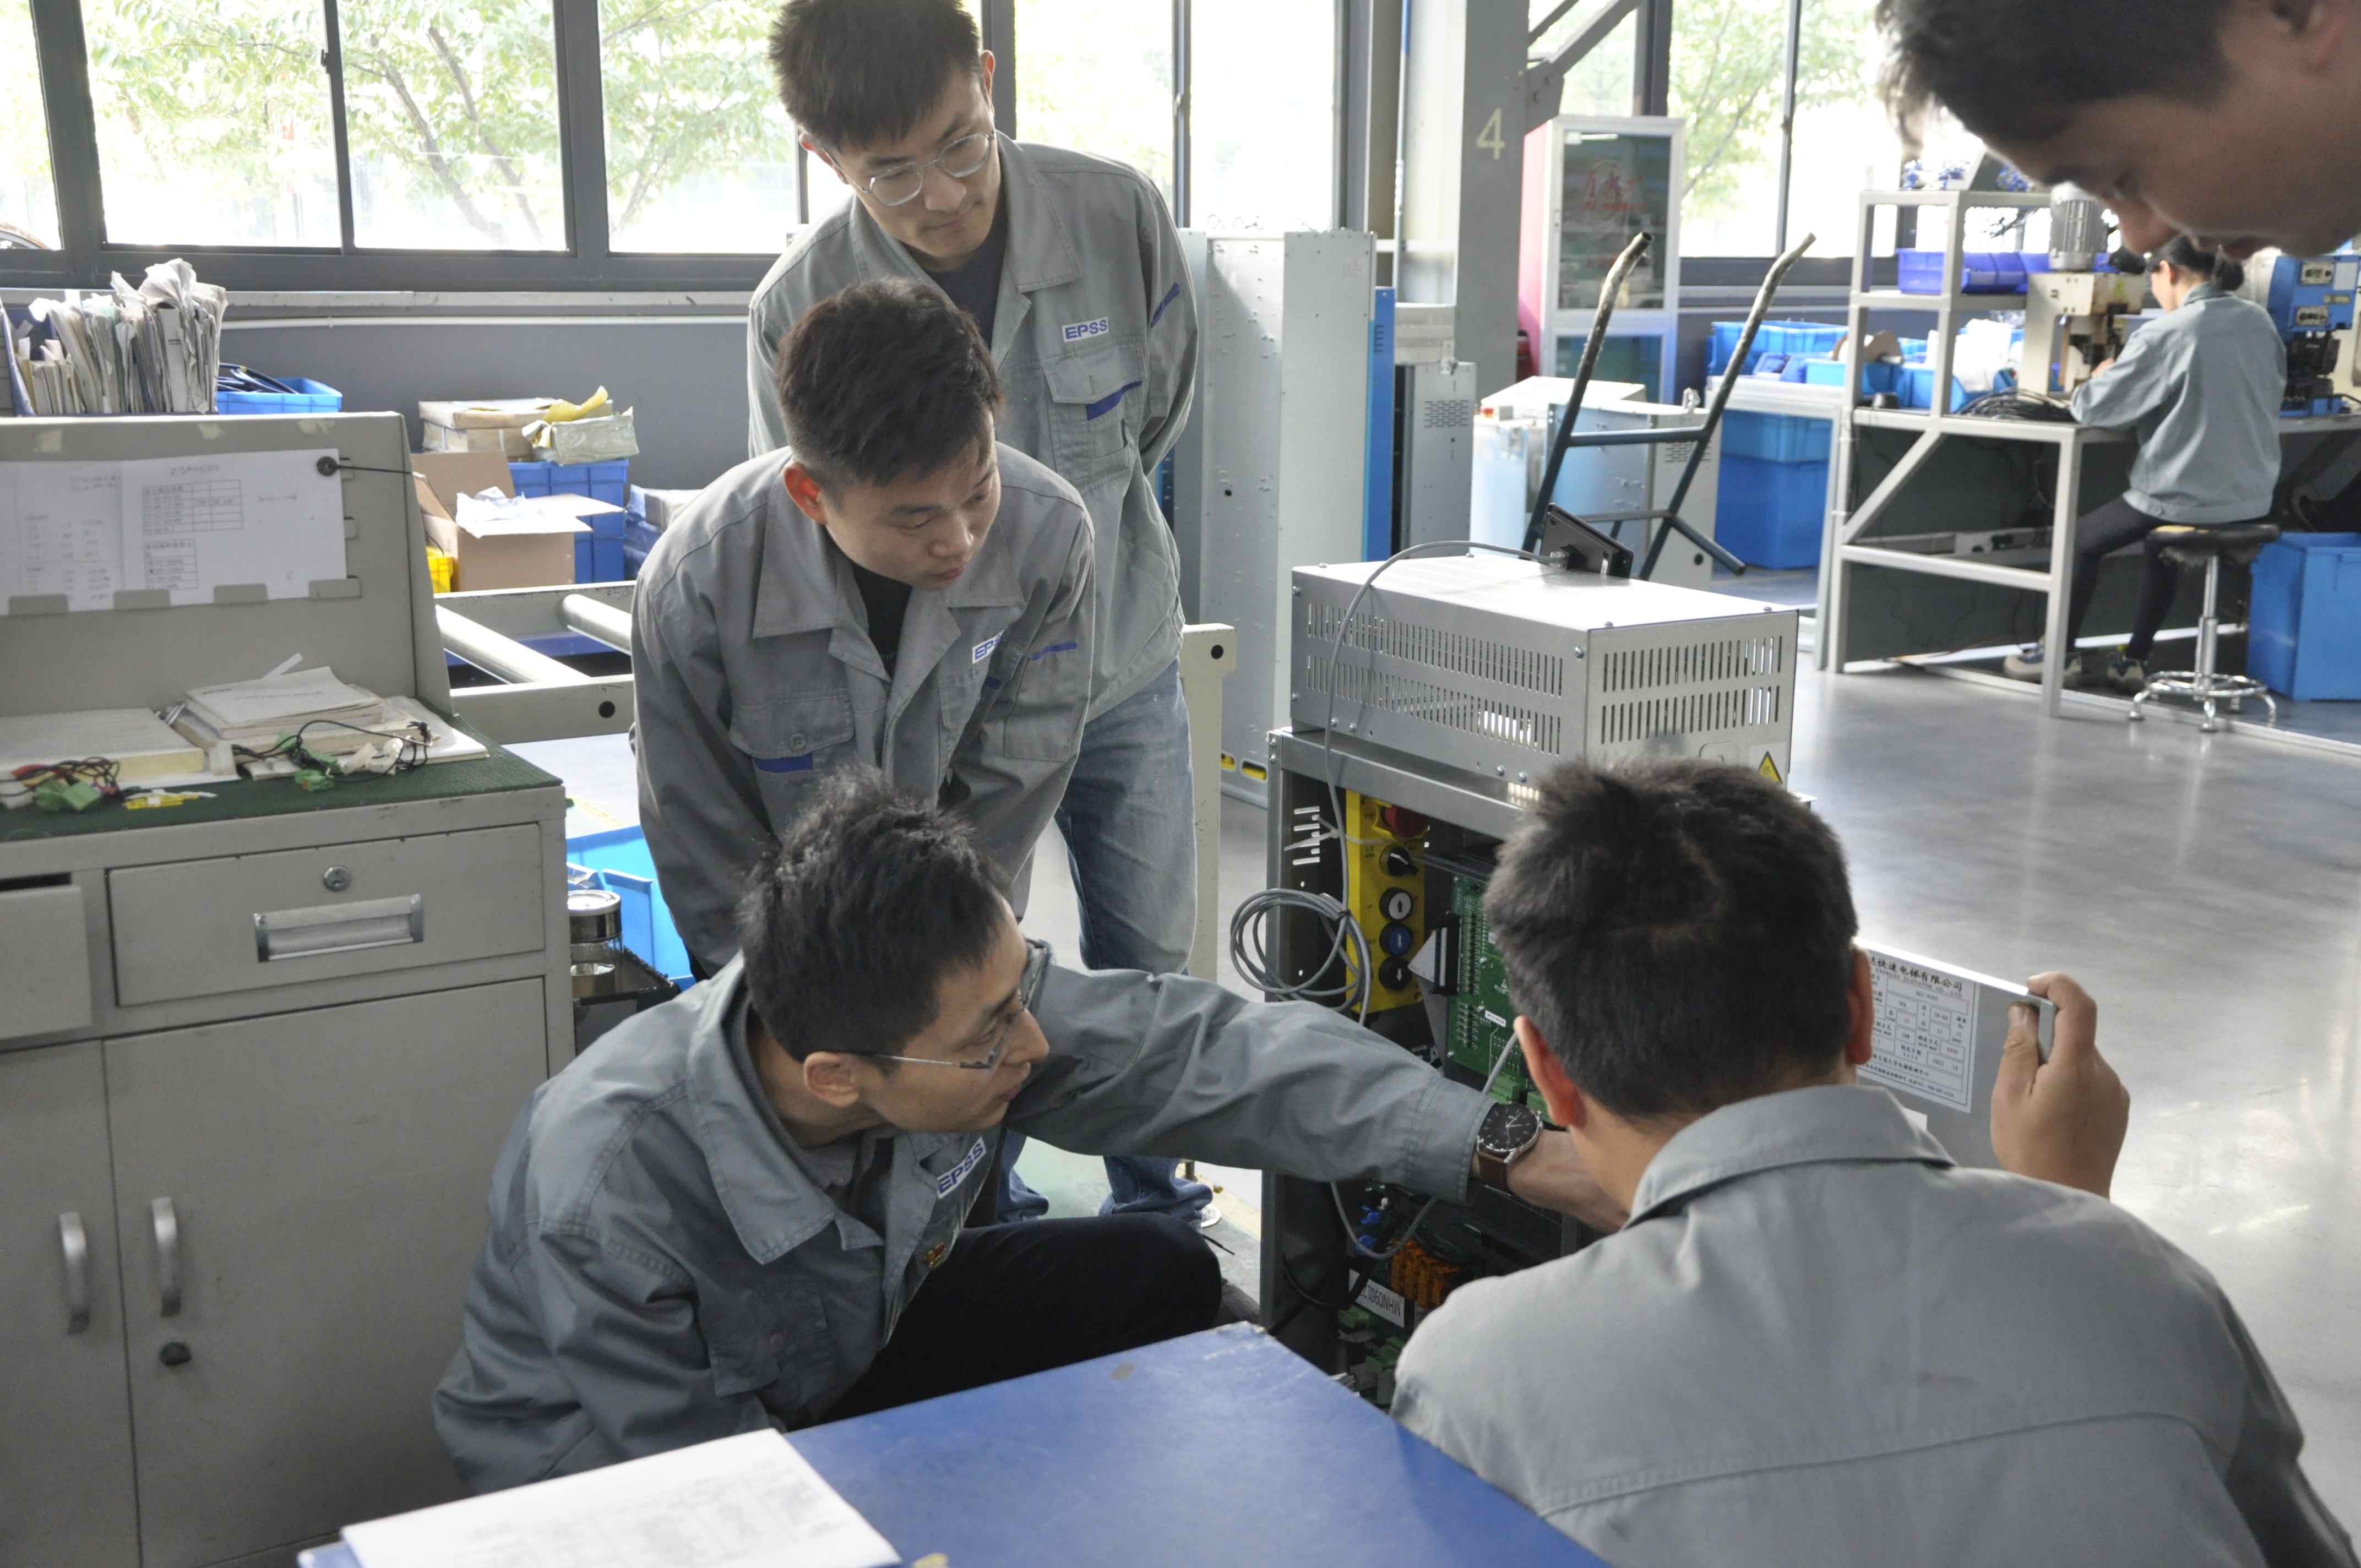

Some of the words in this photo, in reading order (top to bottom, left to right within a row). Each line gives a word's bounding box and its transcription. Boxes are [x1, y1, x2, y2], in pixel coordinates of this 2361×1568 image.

[1476, 107, 1506, 159] 4
[1065, 319, 1107, 339] EPSS
[938, 1144, 983, 1193] EPSS
